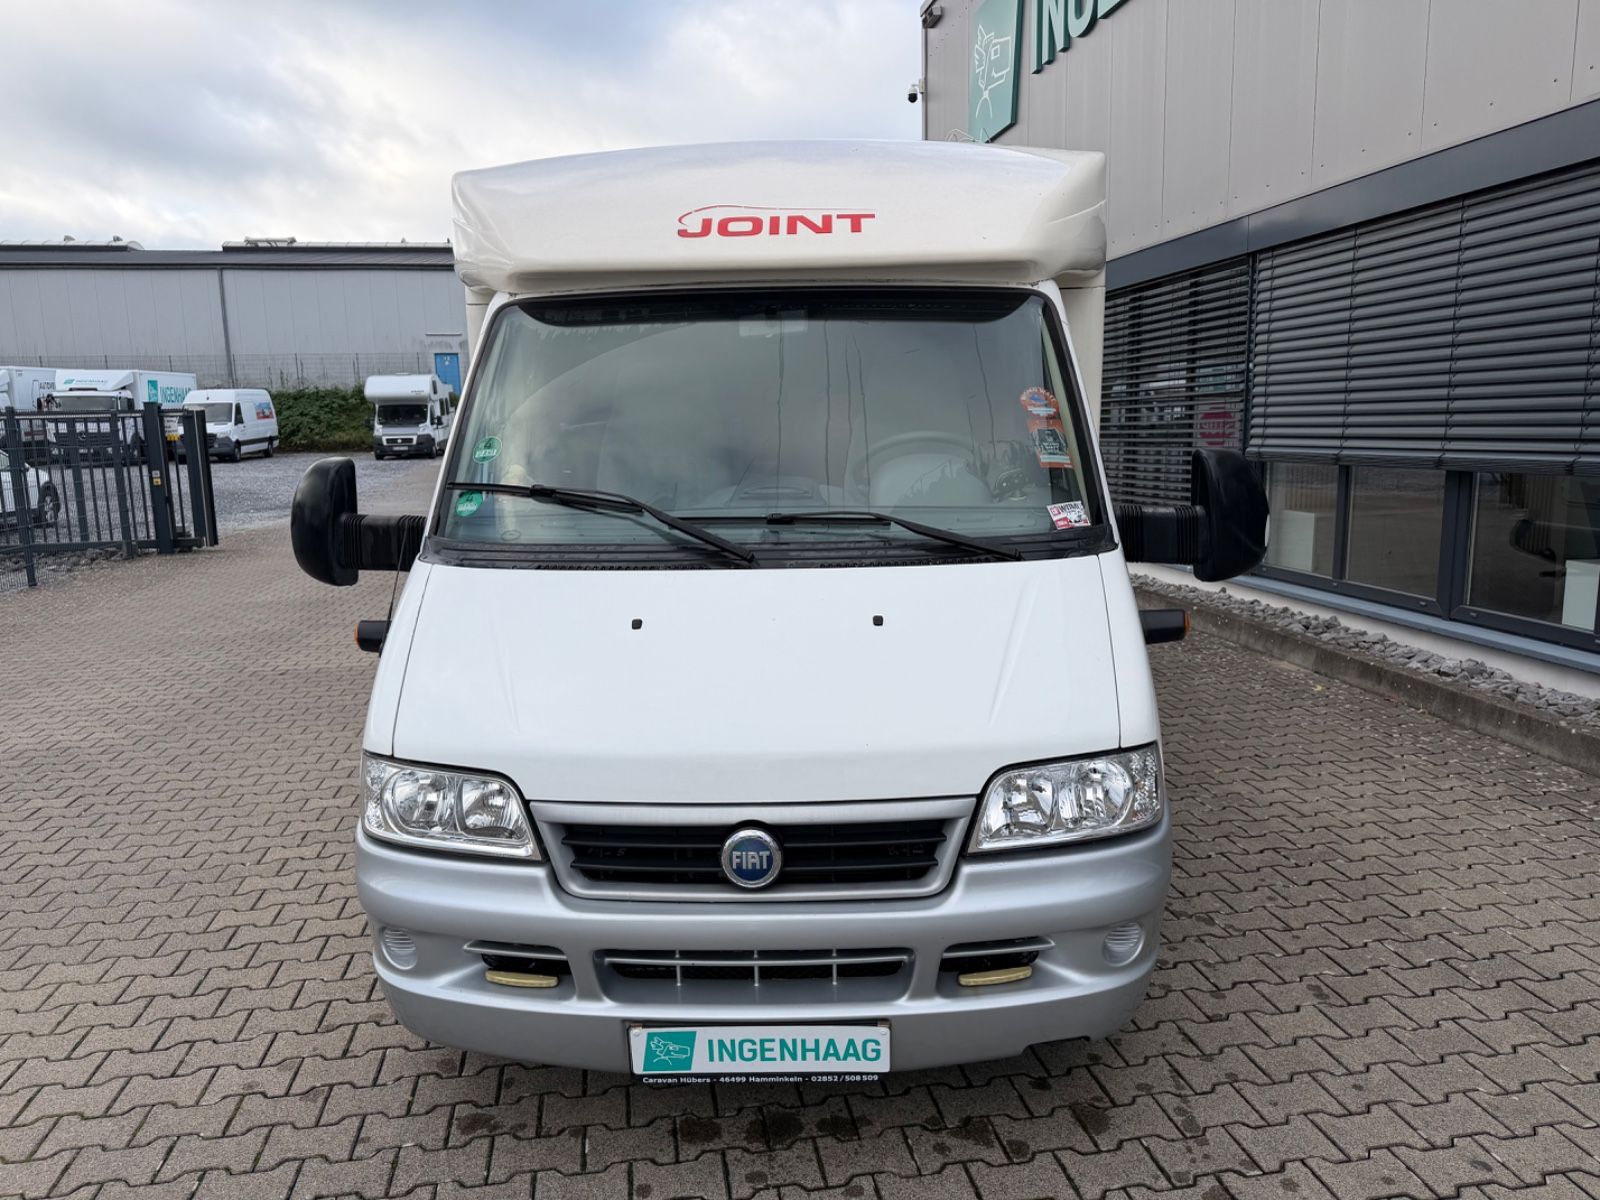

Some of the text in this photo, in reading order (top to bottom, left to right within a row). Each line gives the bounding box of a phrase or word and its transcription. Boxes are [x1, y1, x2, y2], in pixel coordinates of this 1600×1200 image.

[677, 213, 876, 238] JOINT
[731, 850, 771, 870] FIAT
[707, 1038, 882, 1062] INGENHAAG
[642, 1076, 678, 1084] Caravan
[680, 1075, 711, 1084] Hübers
[719, 1075, 746, 1083] 46499
[748, 1075, 803, 1083] Hamminkeln
